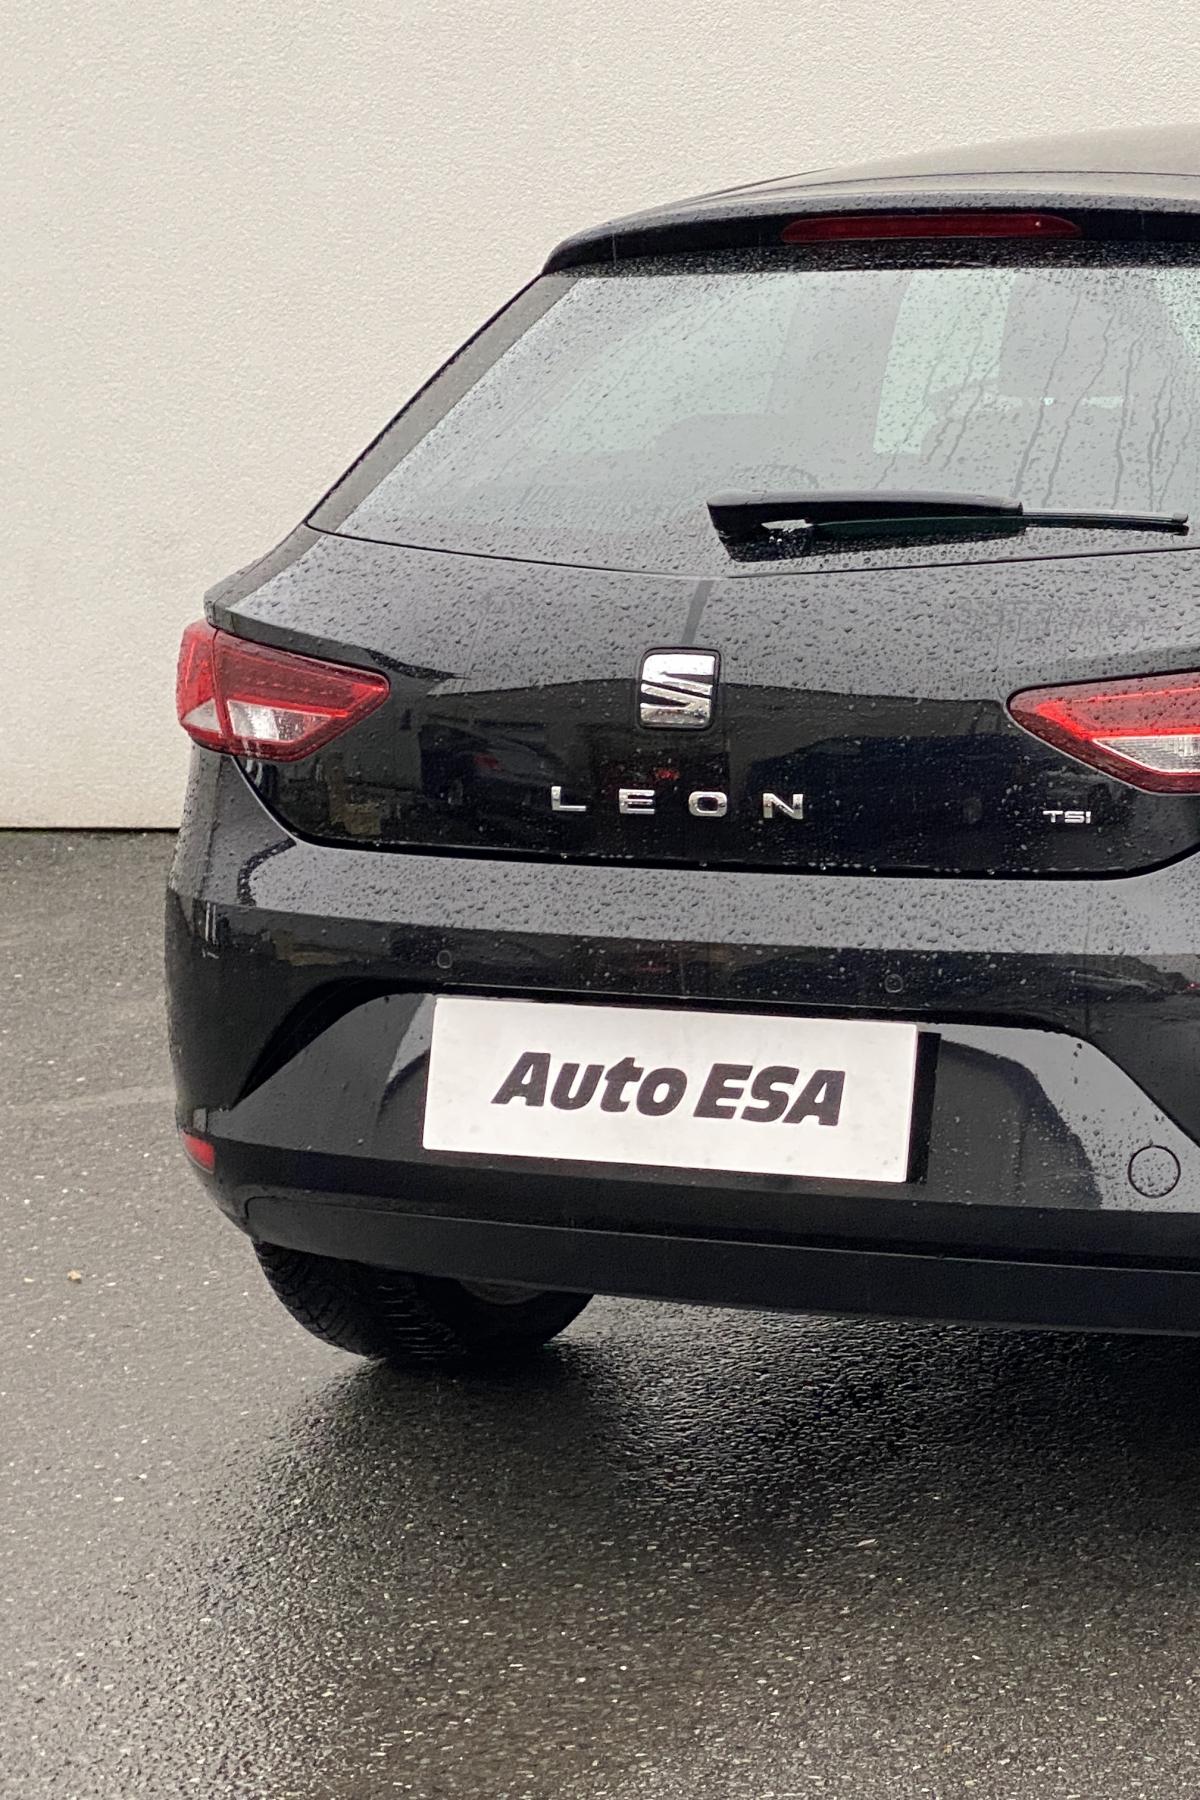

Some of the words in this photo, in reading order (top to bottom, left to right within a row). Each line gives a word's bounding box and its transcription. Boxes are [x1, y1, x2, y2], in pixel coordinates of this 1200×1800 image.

[551, 786, 804, 820] LEON
[1042, 810, 1092, 824] TSI
[491, 1051, 688, 1117] Auto
[692, 1062, 846, 1127] ESA
